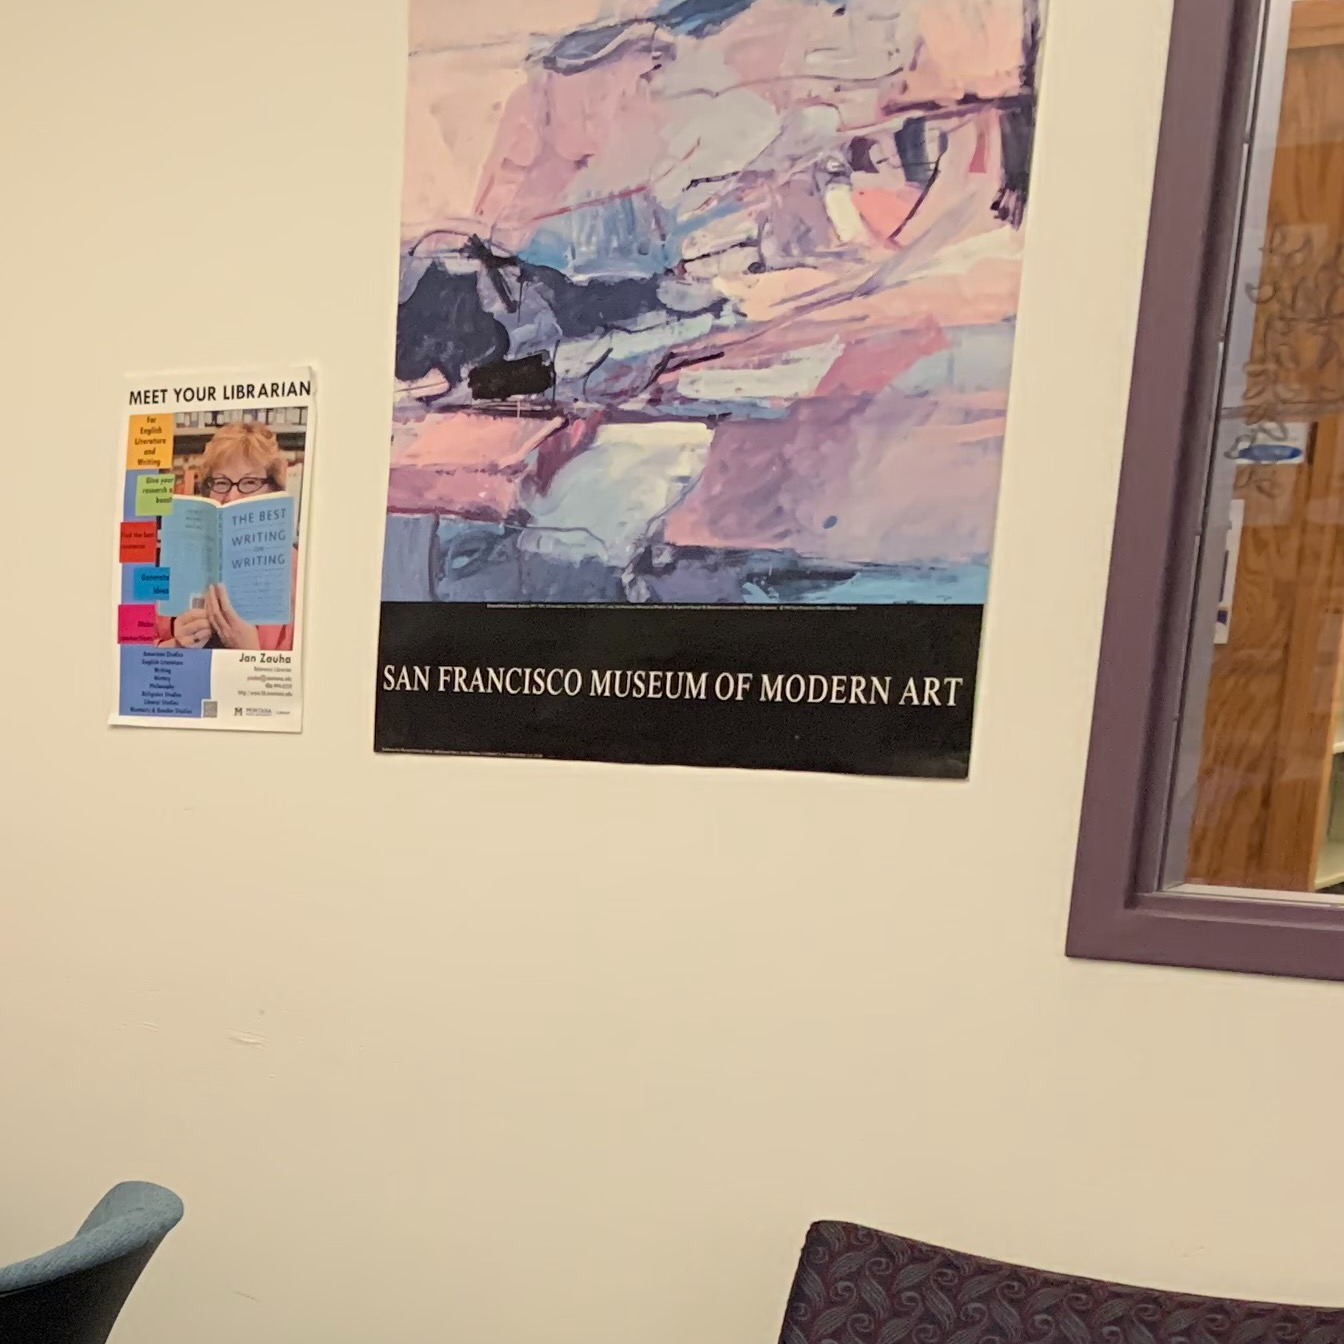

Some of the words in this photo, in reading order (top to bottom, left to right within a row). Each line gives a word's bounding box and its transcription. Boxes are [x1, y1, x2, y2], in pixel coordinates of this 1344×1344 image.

[129, 389, 168, 406] MEET
[173, 386, 217, 403] YOUR
[223, 381, 311, 400] LIBRARIAN
[140, 426, 162, 436] English
[232, 512, 254, 527] THE
[259, 508, 286, 522] BEST
[232, 530, 286, 547] WRITING
[232, 554, 285, 569] WRITING
[239, 652, 256, 663] Jan
[259, 652, 291, 664] Zauha
[383, 664, 431, 691] SAN
[437, 665, 582, 696] FRANCISCO
[589, 669, 709, 700] MUSEUM
[714, 671, 753, 701] OF
[759, 673, 892, 704] MODERN
[898, 676, 963, 707] ART
